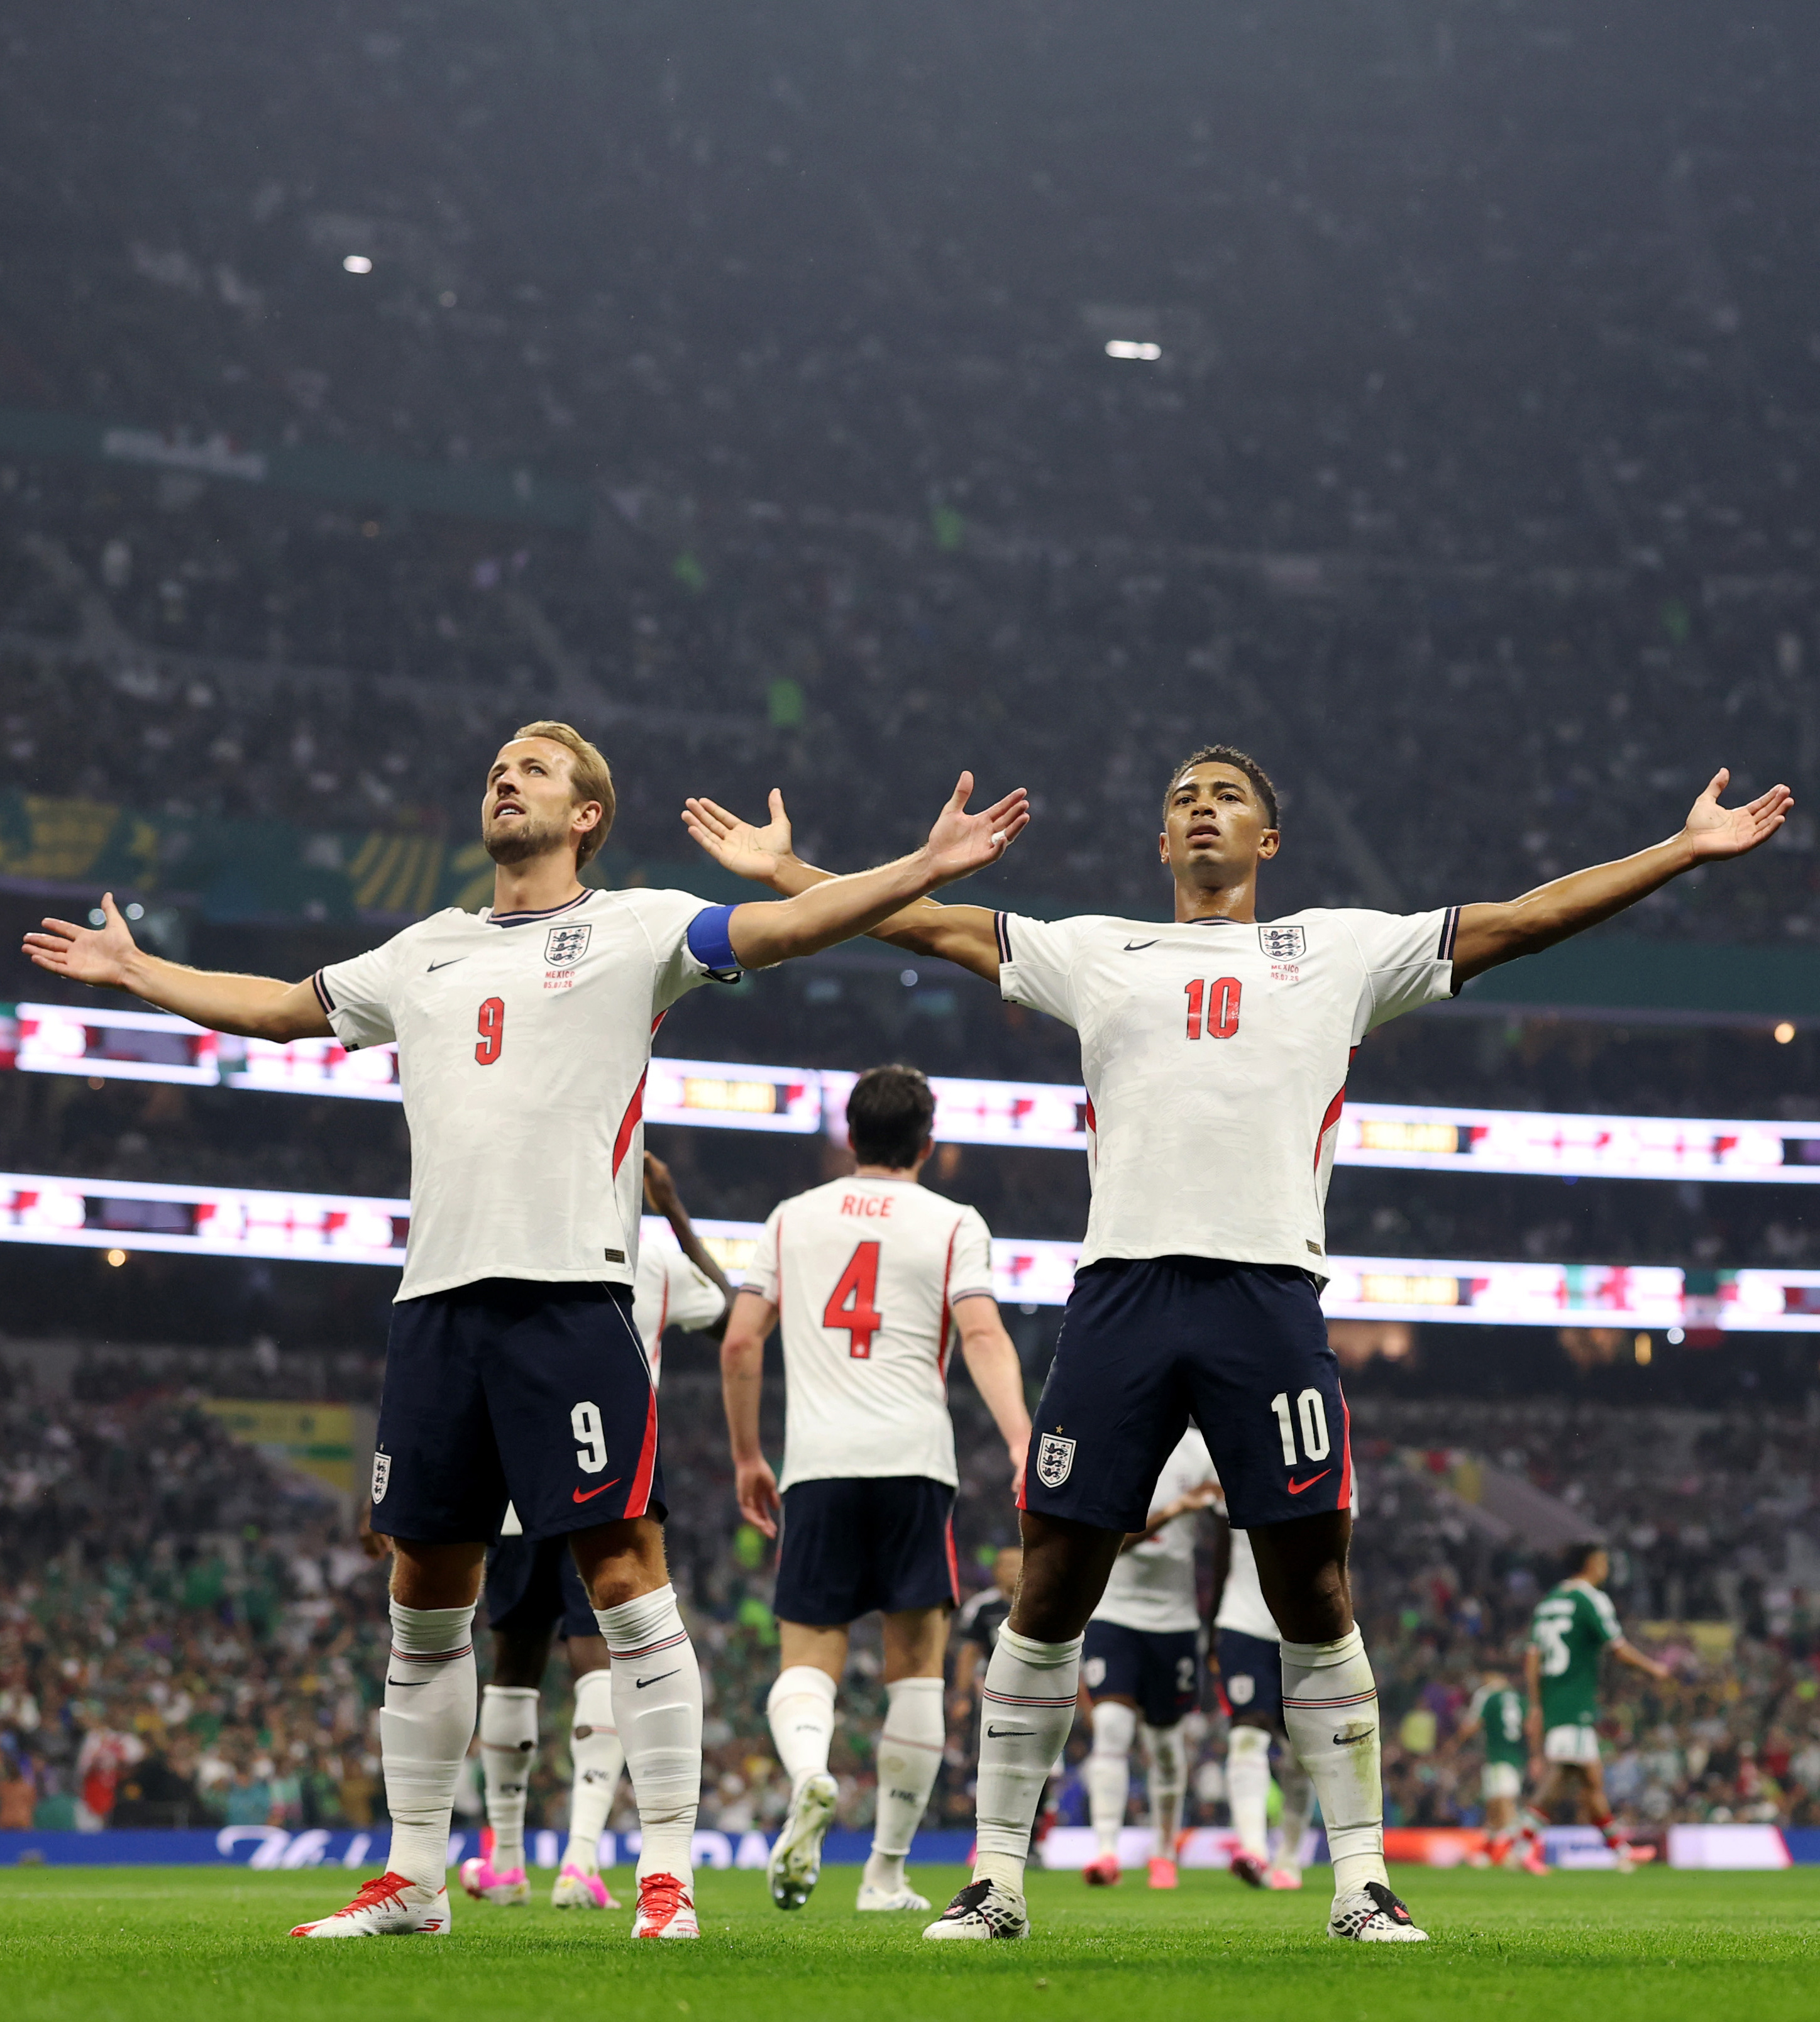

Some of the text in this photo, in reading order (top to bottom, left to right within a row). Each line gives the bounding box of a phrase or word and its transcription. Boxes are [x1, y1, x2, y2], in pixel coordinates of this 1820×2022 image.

[543, 980, 572, 989] 05.07.26
[545, 970, 575, 979] MEXICO
[1271, 964, 1299, 974] MEXICO
[475, 997, 504, 1065] 9
[1184, 977, 1242, 1040] 10
[840, 1194, 895, 1217] RICE
[823, 1240, 882, 1359] 4
[570, 1401, 607, 1473] 9
[1271, 1387, 1330, 1466] 10
